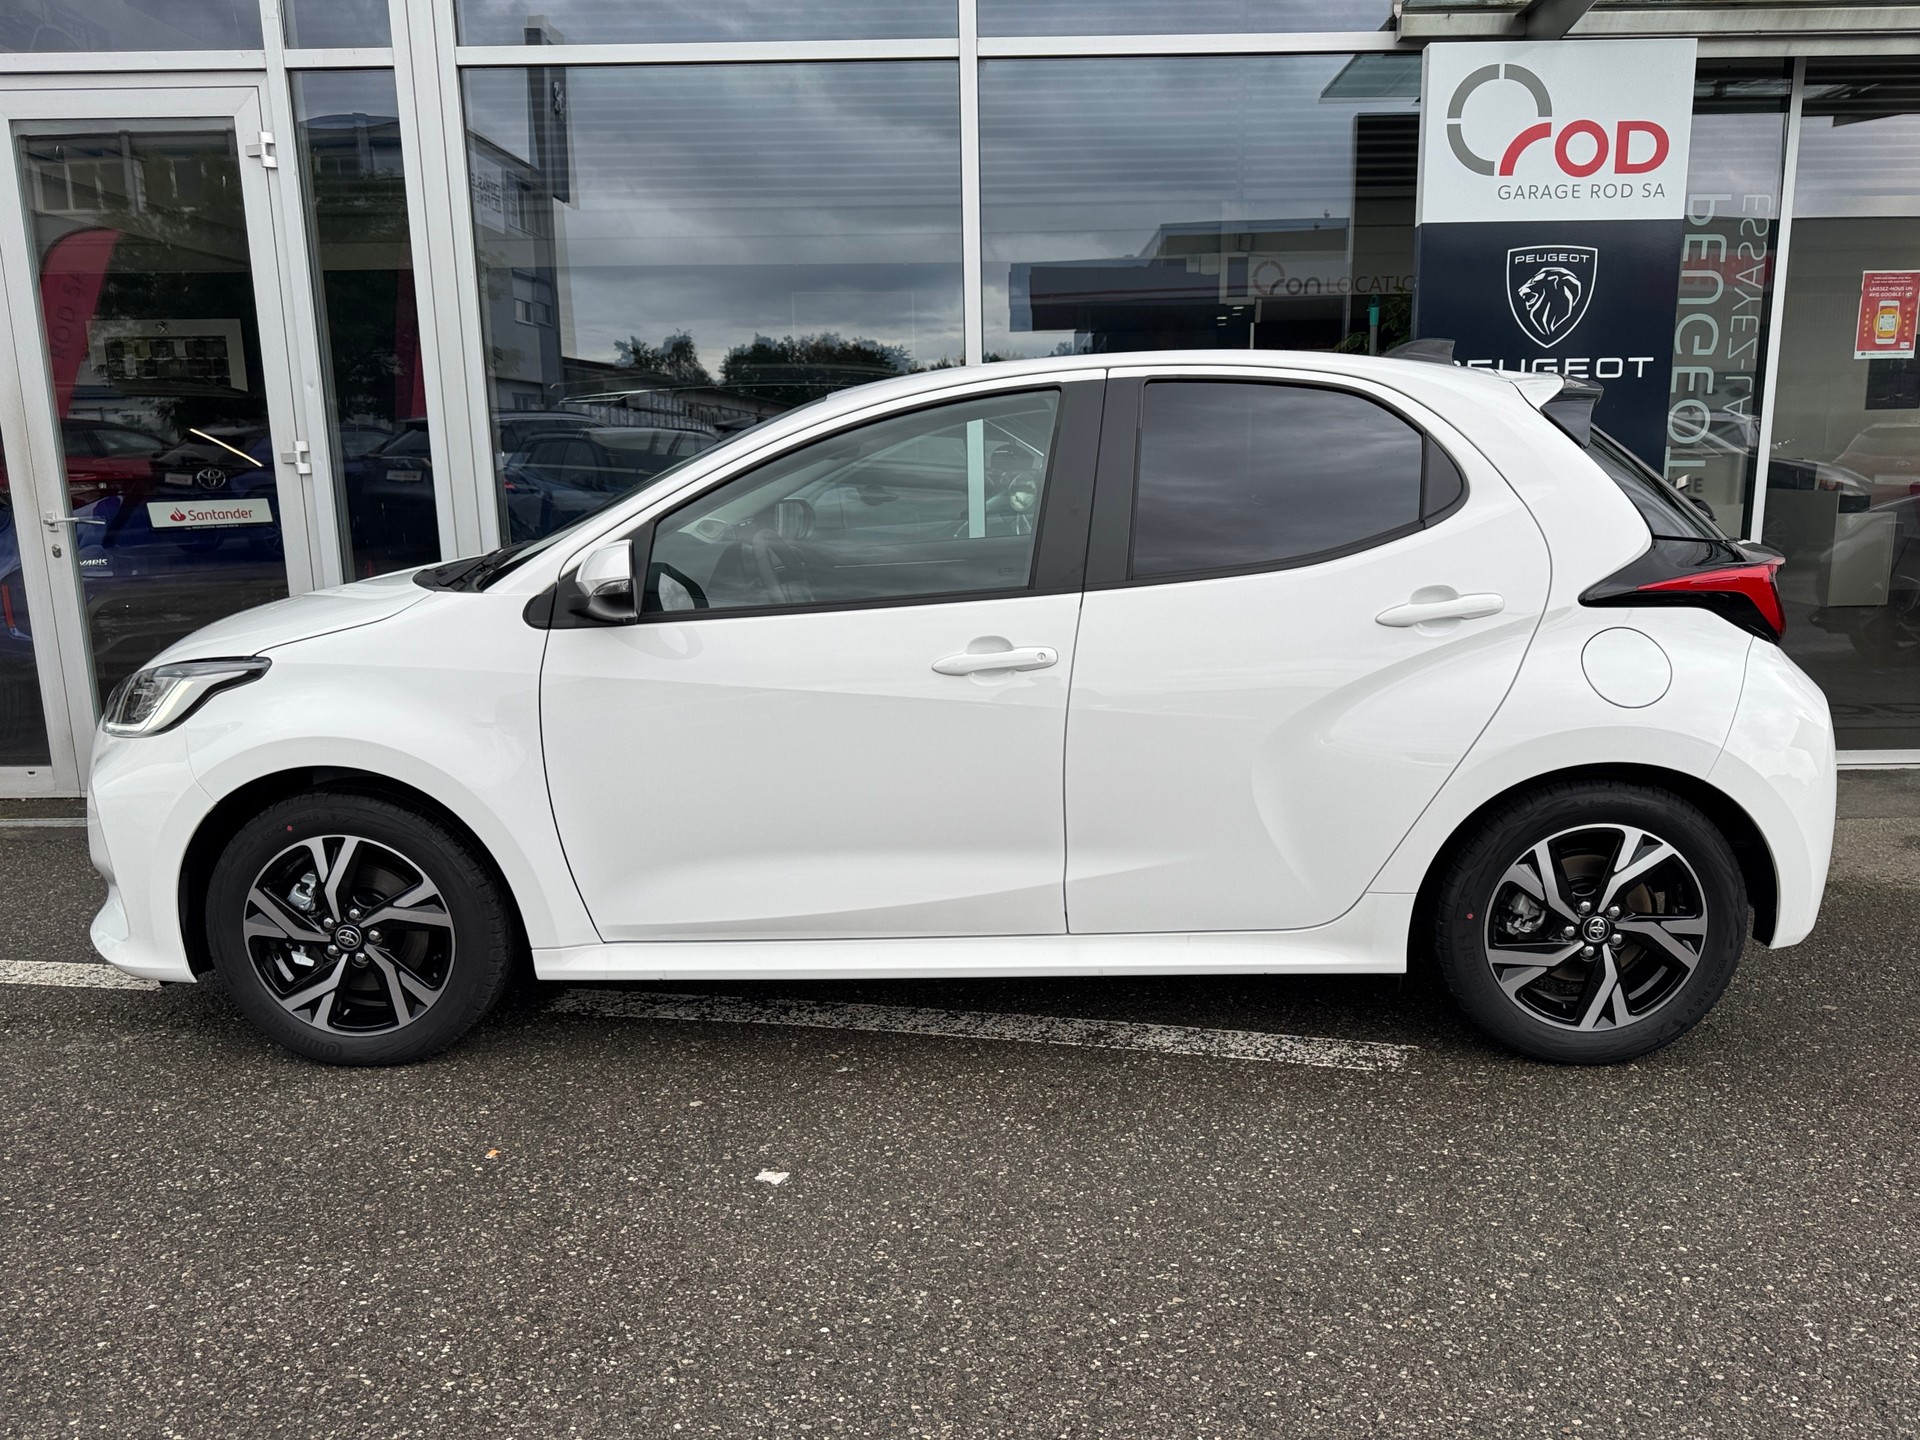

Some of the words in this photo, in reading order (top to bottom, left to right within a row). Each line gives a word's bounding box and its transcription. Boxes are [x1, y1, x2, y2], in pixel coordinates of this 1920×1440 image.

[1497, 183, 1582, 201] GARAGE
[1590, 183, 1634, 199] ROD
[1641, 182, 1666, 199] SA
[1514, 252, 1590, 265] PEUGEOT
[188, 508, 253, 521] Santander
